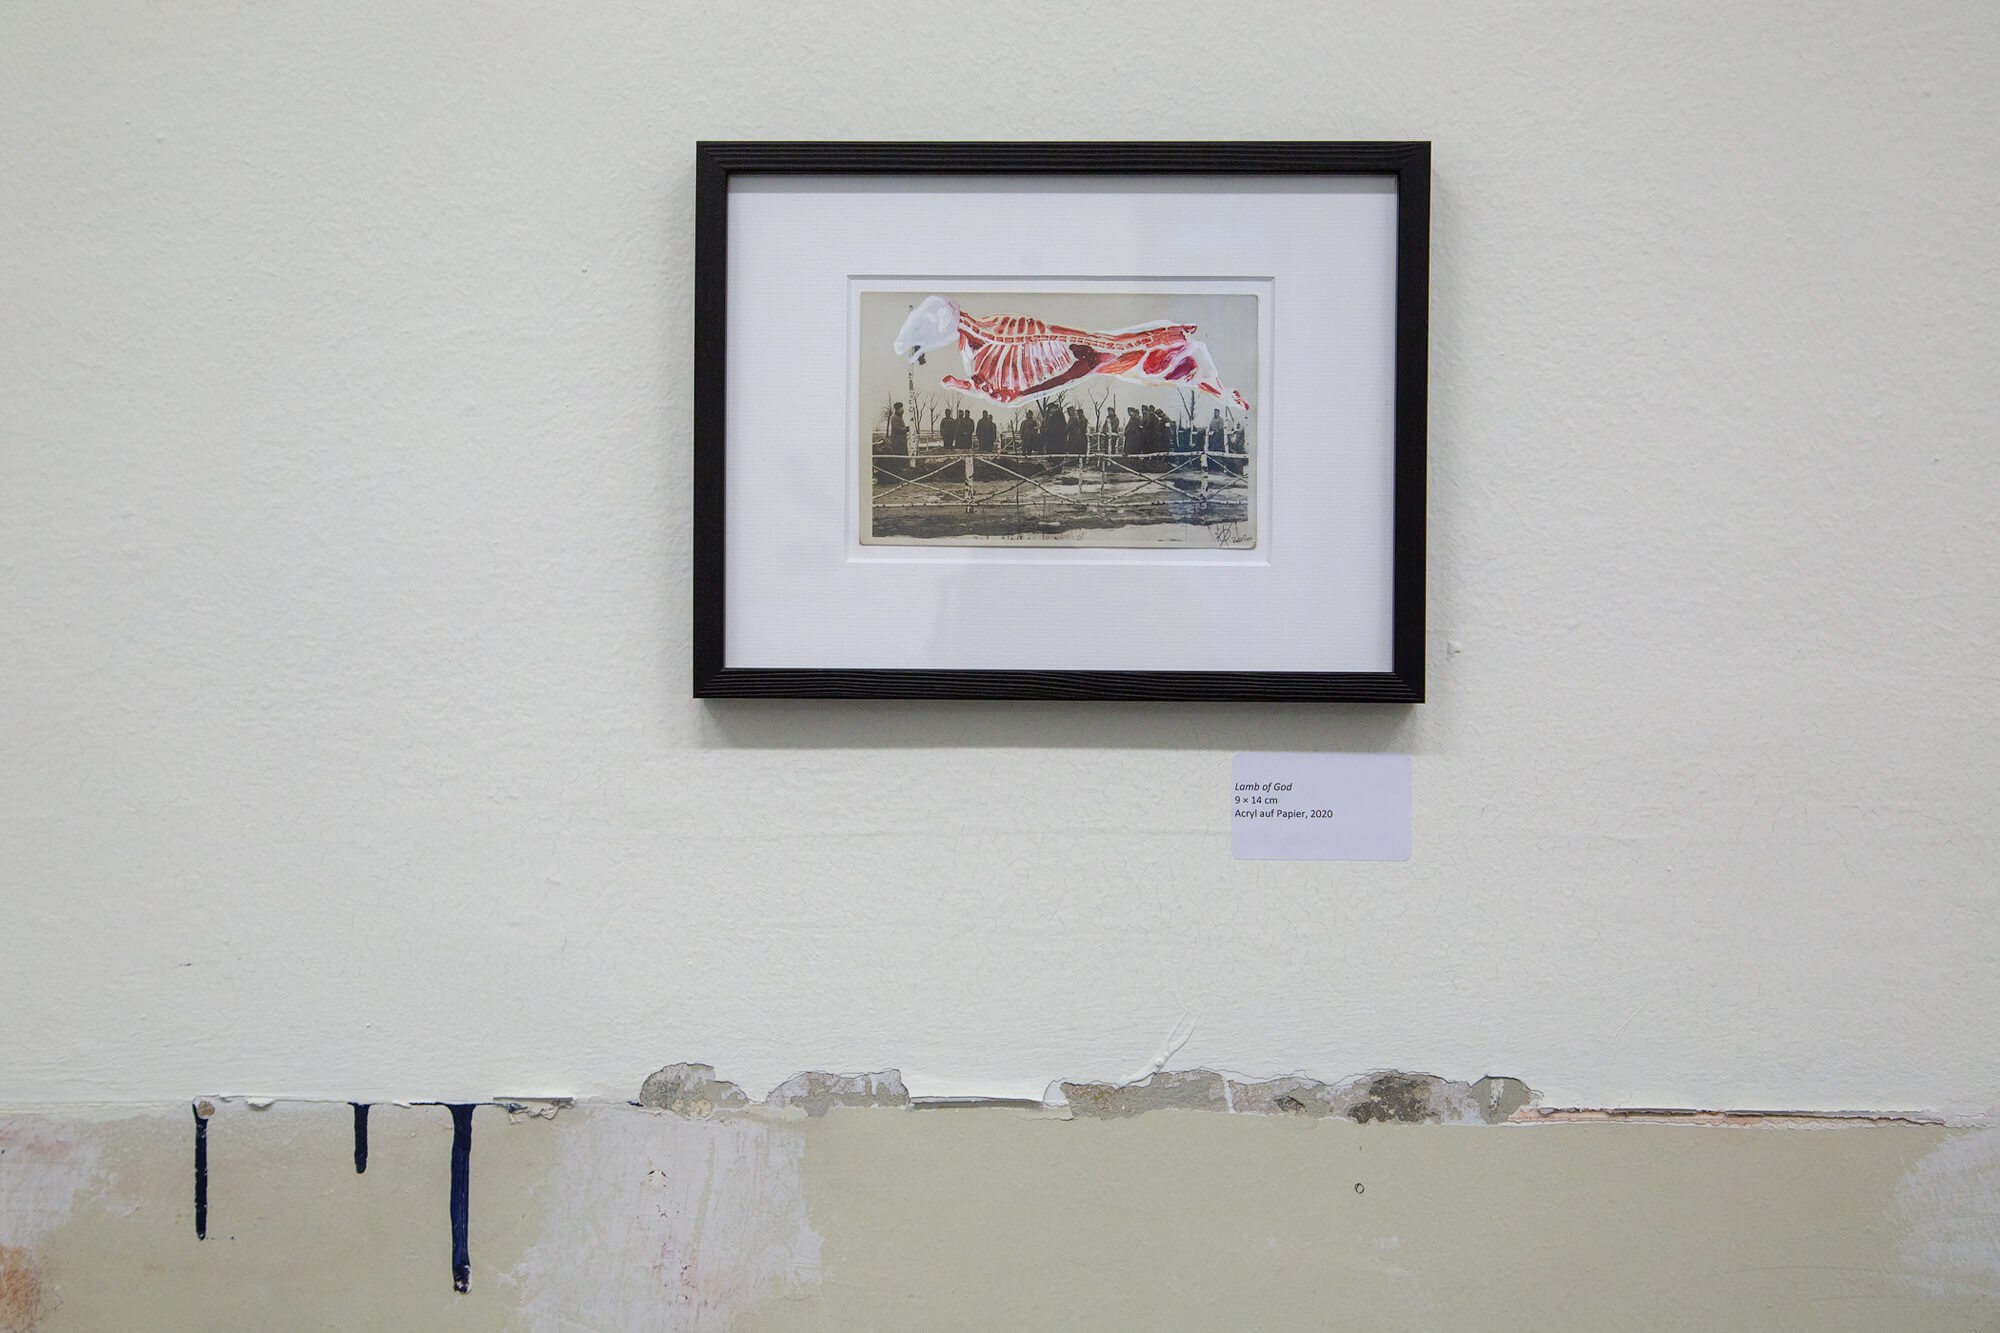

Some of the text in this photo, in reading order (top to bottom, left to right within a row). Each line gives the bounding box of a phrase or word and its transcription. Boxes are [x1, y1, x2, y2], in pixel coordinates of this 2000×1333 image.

[1234, 782, 1293, 793] Lamb of God
[1234, 796, 1241, 804] 9
[1251, 796, 1262, 804] 14
[1234, 809, 1334, 819] Acryl auf Papier, 2020
